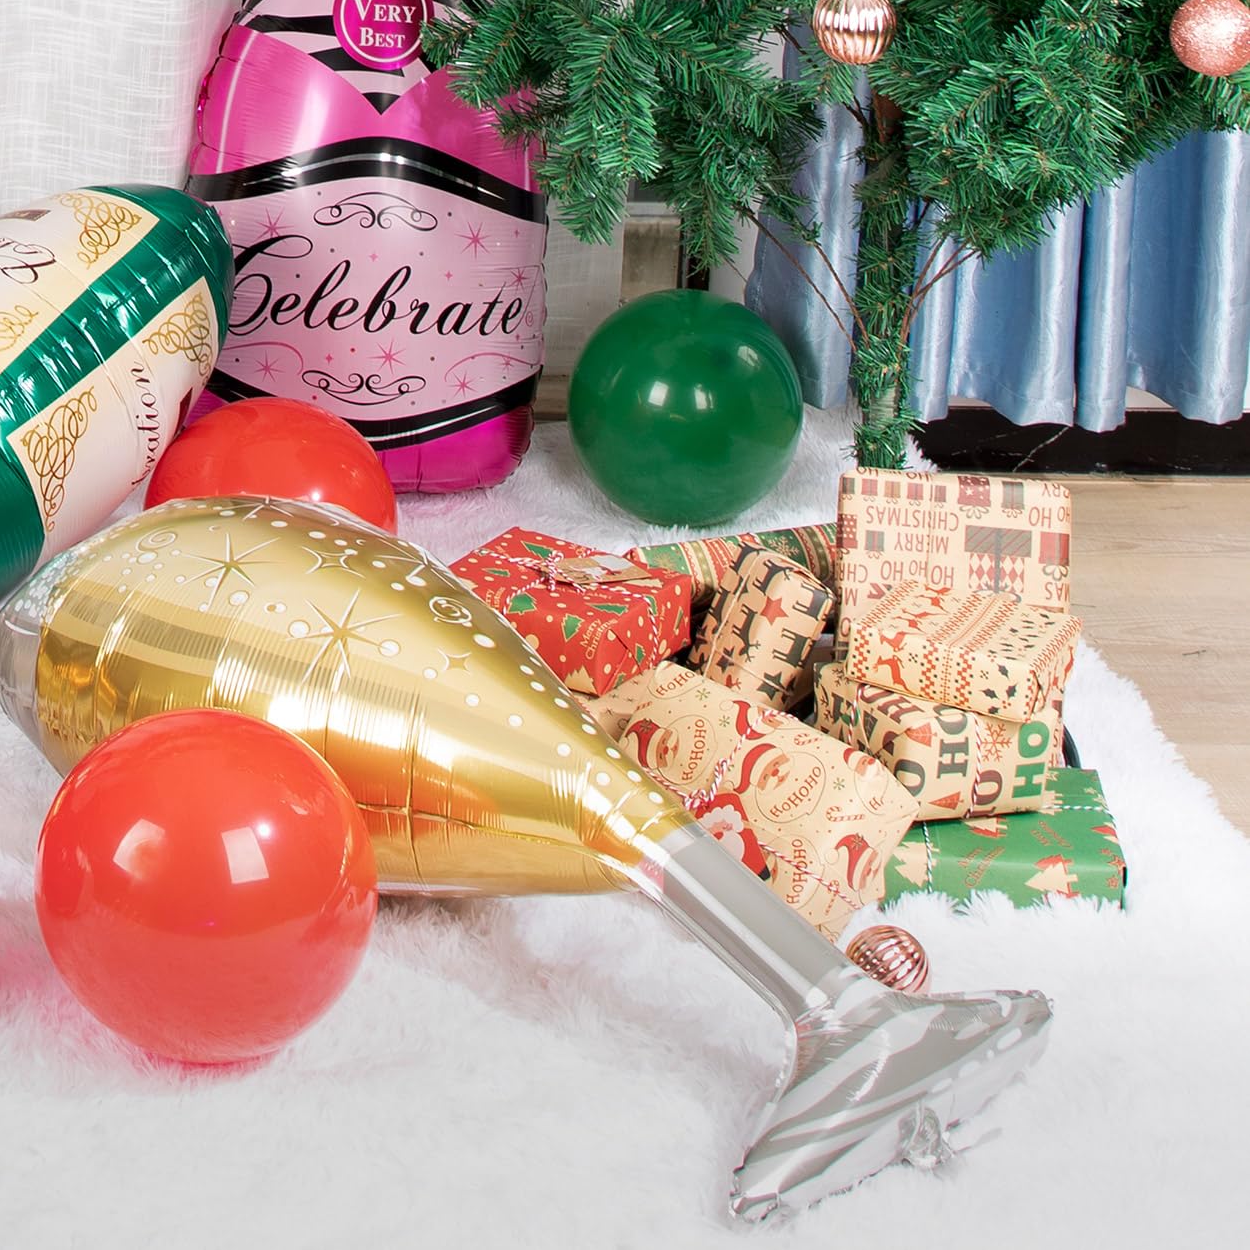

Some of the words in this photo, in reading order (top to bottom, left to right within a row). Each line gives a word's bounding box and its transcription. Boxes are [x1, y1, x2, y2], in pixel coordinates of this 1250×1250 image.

[359, 28, 406, 50] BEST
[226, 233, 527, 338] Celebrate
[865, 504, 960, 533] CHRISTMAS
[1028, 506, 1054, 529] HO
[893, 531, 950, 555] MERRY
[880, 560, 905, 582] HO
[908, 559, 929, 580] HO
[930, 565, 955, 588] HO
[579, 617, 603, 649] Merry
[1011, 719, 1051, 800] HO
